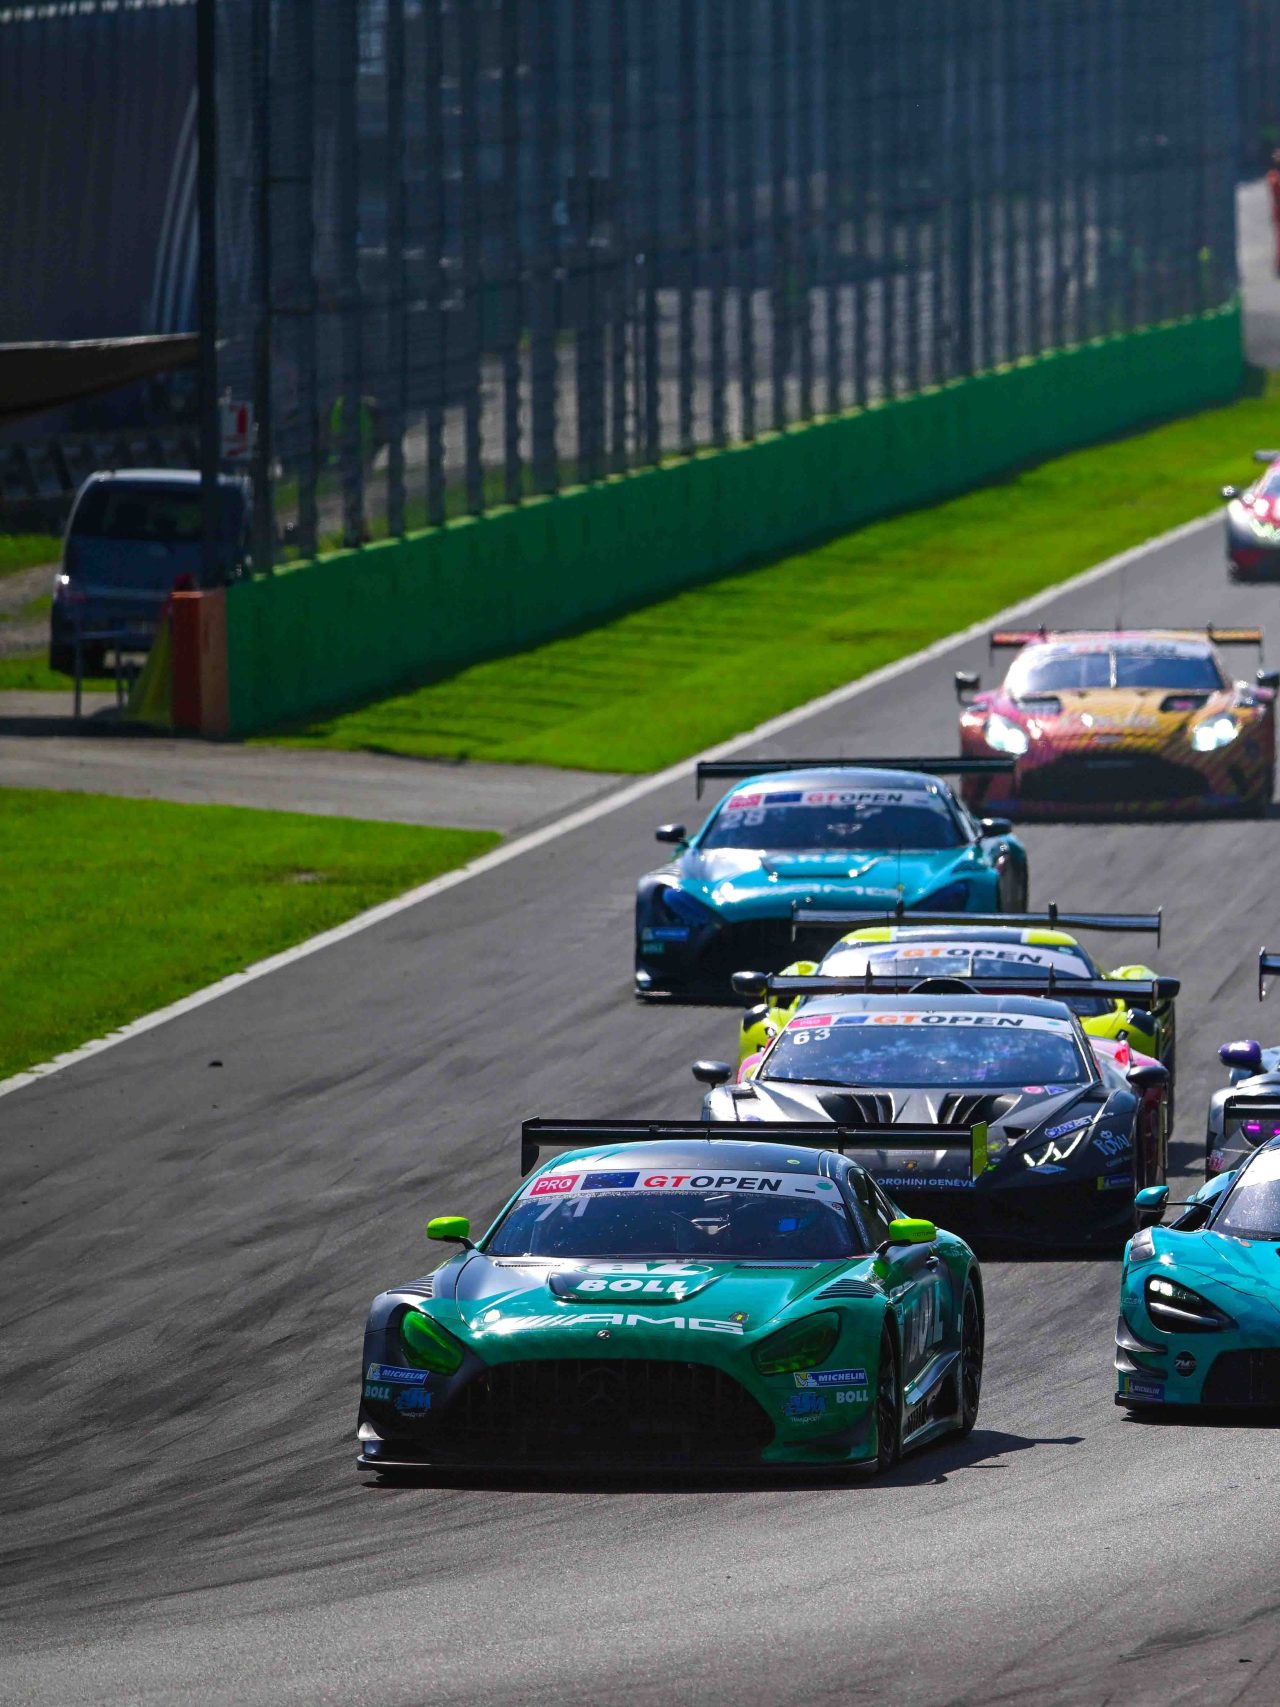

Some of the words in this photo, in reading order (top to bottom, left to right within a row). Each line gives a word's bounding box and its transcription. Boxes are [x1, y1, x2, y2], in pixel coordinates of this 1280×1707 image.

[902, 948, 1044, 965] GTOPEN
[873, 1014, 1024, 1027] GTOPEN
[793, 1026, 831, 1045] 63
[537, 1177, 571, 1194] PRO
[643, 1174, 783, 1192] GTOPEN
[877, 1177, 926, 1186] ORGHINI
[535, 1198, 592, 1222] 71
[576, 1278, 689, 1294] BOLL
[381, 1369, 427, 1380] MICHELIN
[818, 1372, 865, 1382] MICHELIN
[364, 1385, 390, 1399] BOLL
[836, 1389, 869, 1404] BOLL
